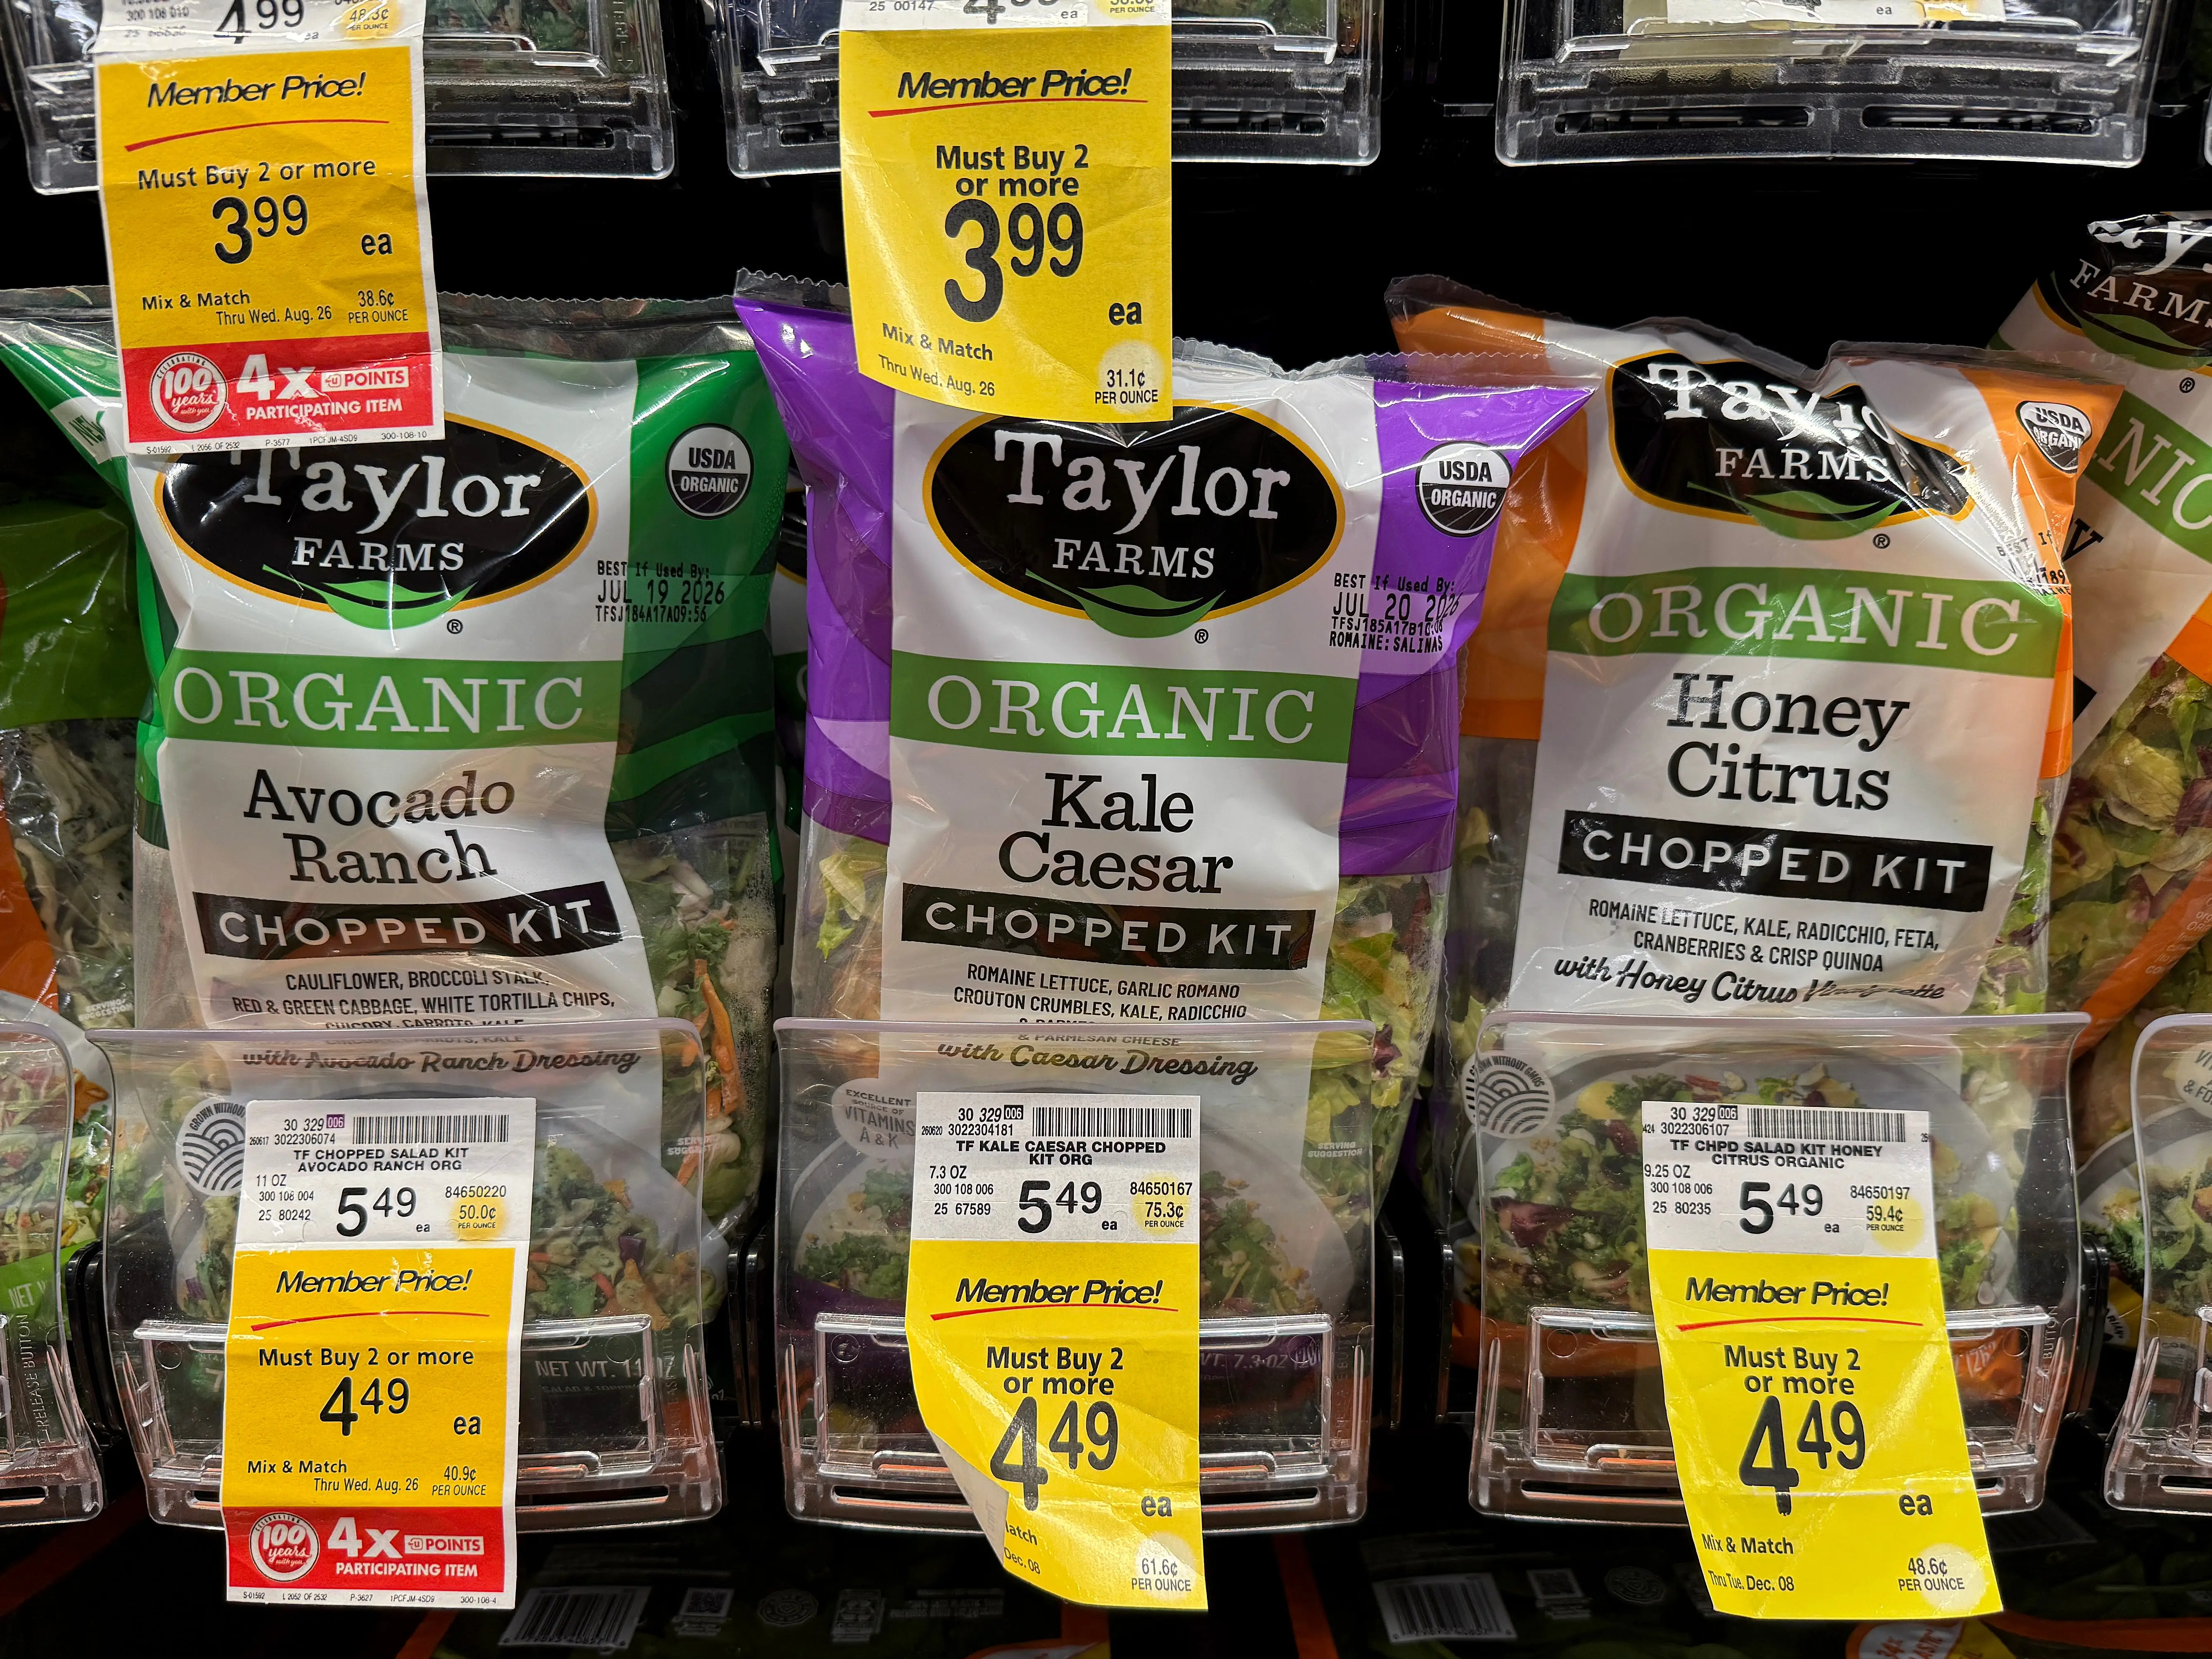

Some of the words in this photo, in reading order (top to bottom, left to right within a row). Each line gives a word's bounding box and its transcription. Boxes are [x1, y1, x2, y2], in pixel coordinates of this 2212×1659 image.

[148, 78, 275, 107] Member
[282, 72, 366, 100] Price!
[138, 169, 196, 189] Must
[206, 166, 247, 189] Buy
[258, 163, 270, 181] 2
[280, 163, 304, 180] or
[313, 159, 375, 178] more
[360, 232, 393, 256] ea
[142, 296, 172, 310] Mix
[180, 294, 191, 307] &
[197, 290, 250, 306] Match
[358, 289, 394, 307] 38.6¢
[216, 310, 244, 326] Thru
[249, 308, 280, 323] Wed.
[285, 308, 314, 324] Aug.
[318, 306, 331, 320] 26
[348, 311, 369, 323] PER
[372, 309, 408, 322] OUNCE
[344, 371, 405, 386] POINTS
[1106, 369, 1145, 389] 31.1¢
[1095, 392, 1116, 405] PER
[1121, 390, 1158, 403] OUNCE
[246, 403, 362, 420] PARTICIPATING
[366, 400, 402, 412] ITEM
[688, 447, 736, 470] USDA
[1714, 446, 1890, 483] FARMS
[994, 428, 1291, 535] Taylor
[1438, 461, 1492, 483] USDA
[232, 449, 541, 534] Taylor
[680, 475, 739, 495] ORGANIC
[1431, 488, 1496, 508] ORGANIC
[293, 537, 465, 571] FARMS
[1053, 538, 1216, 578] FARMS
[598, 560, 627, 576] BEST
[636, 562, 648, 576] If
[657, 562, 683, 578] Used
[691, 564, 709, 581] By:
[598, 580, 632, 603] JUL
[648, 580, 669, 604] 19
[681, 581, 724, 604] 2026
[1333, 591, 1369, 618] JUL
[1385, 593, 1410, 621] 20
[1425, 592, 1463, 622] 2026
[1588, 583, 2020, 656] ORGANIC
[173, 667, 583, 735] ORGANIC
[927, 674, 1314, 744] ORGANIC
[1666, 671, 1909, 753] Honey
[1667, 741, 1890, 811] Citrus
[244, 768, 515, 828] Avocado
[1041, 773, 1194, 833] Kale
[284, 831, 498, 885] Ranch
[998, 830, 1234, 894] Caesar
[218, 912, 487, 948] CHOPPED
[509, 899, 592, 944] KIT
[925, 902, 1187, 948] CHOPPED
[1209, 925, 1292, 955] KIT
[1589, 898, 1657, 925] ROMAINE
[1662, 905, 1739, 934] LETTUCE,
[1744, 915, 1791, 940] KALE,
[1795, 919, 1890, 948] RADICCHIO,
[1894, 928, 1940, 951] FETA,
[1633, 930, 1747, 962] CRANBERRIES
[1751, 943, 1764, 963] &
[1768, 943, 1818, 966] CRISP
[1822, 947, 1883, 972] QUINOA
[286, 972, 403, 991] CAULIFLOWER,
[409, 970, 487, 988] BROCCOLI
[493, 969, 550, 986] STALK,
[967, 963, 1035, 987] ROMAINE
[1040, 972, 1112, 995] LETTUCE,
[1117, 980, 1173, 998] GARLIC
[1177, 983, 1240, 1000] ROMANO
[232, 997, 262, 1014] RED
[267, 1000, 279, 1014] &
[283, 999, 334, 1015] GREEN
[340, 998, 418, 1015] CABBAGE,
[422, 995, 475, 1014] WHITE
[479, 992, 558, 1011] TORTILLA
[563, 992, 615, 1009] CHIPS,
[953, 986, 1025, 1009] CROUTON
[1030, 995, 1115, 1018] CRUMBLES,
[1119, 1001, 1163, 1020] KALE,
[1168, 1002, 1247, 1021] RADICCHIO
[284, 1119, 298, 1131] 30
[303, 1117, 324, 1131] 329
[327, 1116, 344, 1128] 006
[1661, 1124, 1729, 1136] 3022306107
[249, 1136, 269, 1146] 260617
[274, 1133, 336, 1145] 3022306074
[956, 1141, 974, 1152] TF
[979, 1141, 1019, 1152] KALE
[1024, 1142, 1087, 1152] CAESAR
[1091, 1142, 1166, 1153] CHOPPED
[1670, 1140, 1689, 1152] TF
[1695, 1140, 1738, 1152] CHPD
[1743, 1141, 1794, 1154] SALAD
[1800, 1143, 1826, 1155] KIT
[1830, 1145, 1882, 1157] HONEY
[294, 1149, 309, 1159] TF
[315, 1149, 385, 1159] CHOPPED
[391, 1148, 439, 1158] SALAD
[445, 1147, 469, 1157] KIT
[1029, 1155, 1053, 1165] KIT
[1060, 1155, 1093, 1165] ORG
[1712, 1155, 1769, 1166] CITRUS
[1774, 1156, 1844, 1168] ORGANIC
[298, 1161, 367, 1172] AVOCADO
[374, 1161, 424, 1171] RANCH
[430, 1160, 462, 1170] ORG
[929, 1166, 946, 1179] 7.3
[950, 1166, 967, 1179] OZ
[1644, 1165, 1669, 1177] 9.25
[1673, 1165, 1690, 1178] OZ
[259, 1191, 276, 1201] 300
[279, 1191, 294, 1200] 108
[297, 1191, 314, 1200] 004
[445, 1185, 506, 1198] 84650220
[1130, 1182, 1193, 1196] 84650167
[1850, 1186, 1910, 1199] 84650197
[258, 1210, 271, 1221] 25
[279, 1209, 311, 1221] 80242
[459, 1205, 496, 1220] 50.0¢
[1145, 1202, 1183, 1218] 75.3¢
[1866, 1206, 1903, 1222] 59.4¢
[443, 1466, 476, 1481] 40.9¢
[432, 1485, 450, 1495] PER
[453, 1484, 486, 1495] OUNCE
[1702, 1533, 1722, 1553] Mix
[1726, 1537, 1736, 1553] &
[1742, 1536, 1793, 1555] Match
[1141, 1558, 1178, 1576] 61.6¢
[1908, 1557, 1947, 1575] 48.6¢
[1708, 1569, 1727, 1589] Thru
[1728, 1573, 1744, 1589] Tue.
[1747, 1574, 1775, 1591] Dec.
[1778, 1576, 1794, 1591] 08
